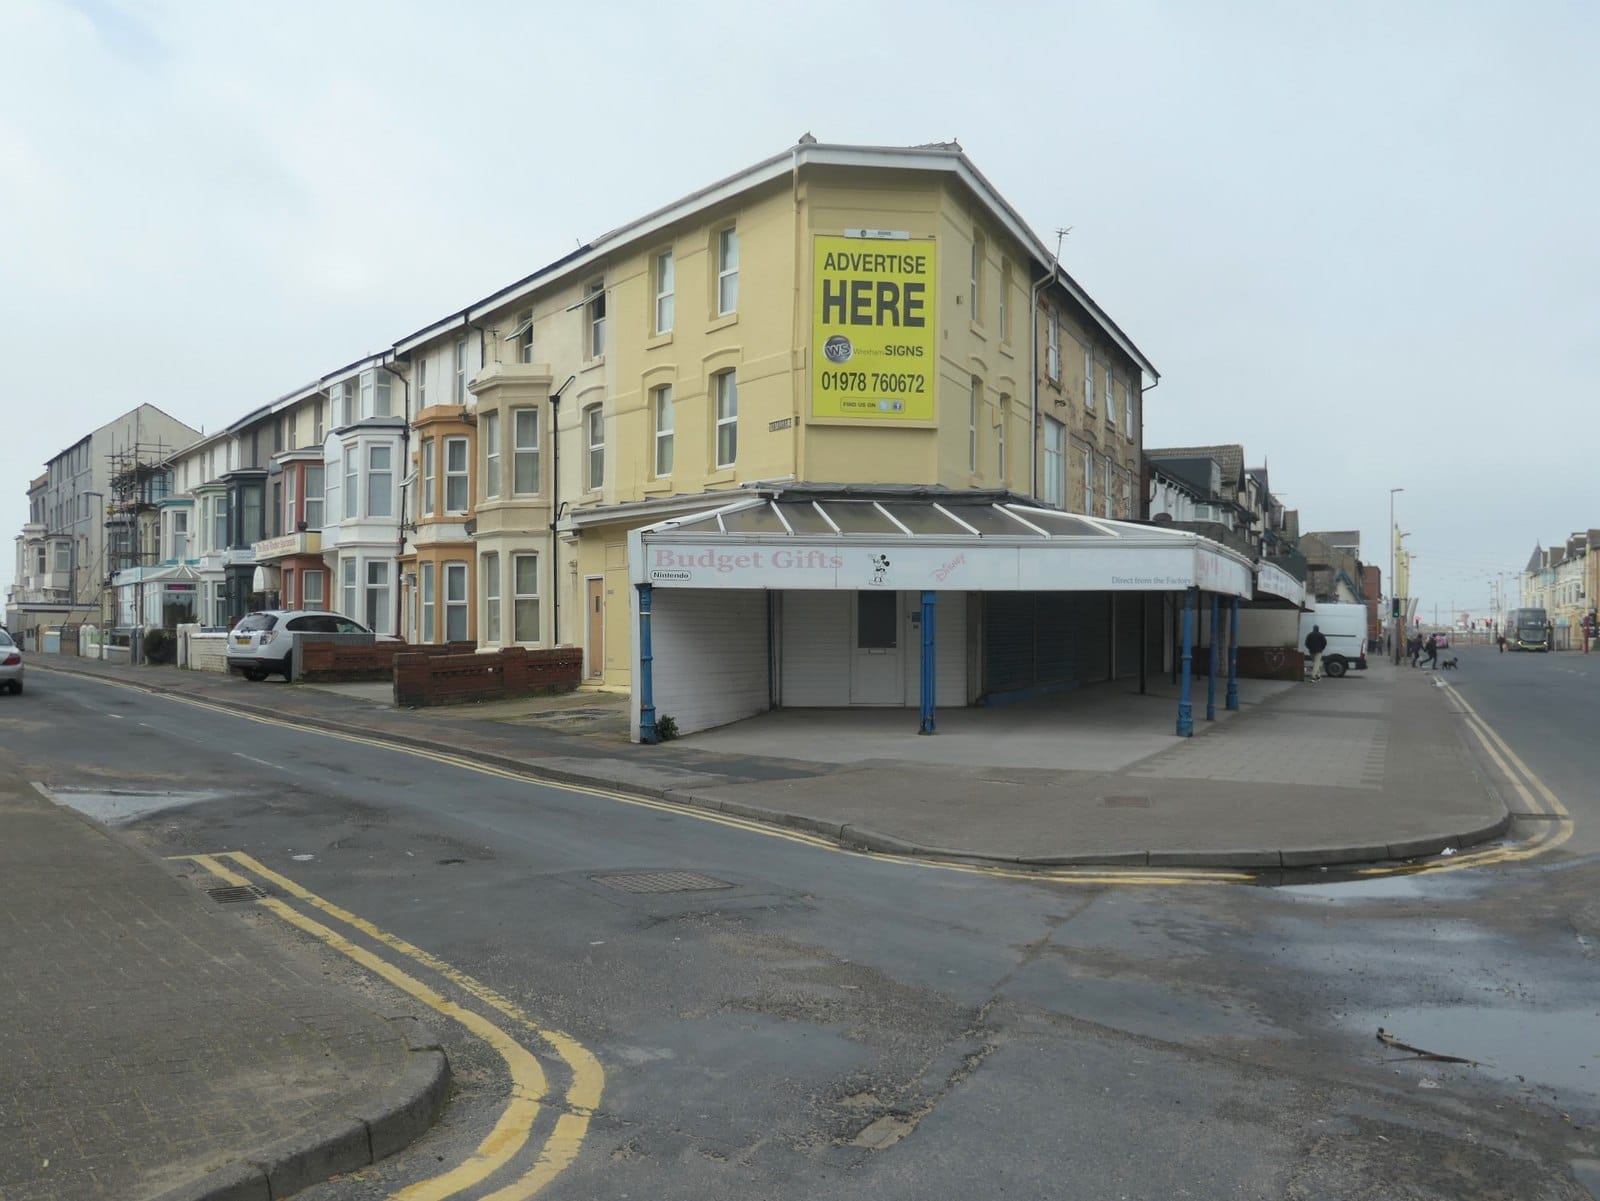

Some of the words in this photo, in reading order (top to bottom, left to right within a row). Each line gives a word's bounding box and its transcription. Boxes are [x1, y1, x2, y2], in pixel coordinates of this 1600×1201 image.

[824, 252, 926, 274] ADVERTISE
[822, 279, 926, 328] HERE
[826, 343, 850, 357] WS
[884, 345, 923, 357] SIGNS
[821, 371, 867, 391] 01978
[871, 373, 925, 393] 760672
[655, 549, 763, 573] Budget
[771, 550, 844, 569] Gifts
[653, 571, 690, 579] Nintendo
[1111, 576, 1134, 585] Direct
[1134, 576, 1152, 585] from
[1153, 576, 1165, 584] the
[1166, 576, 1191, 586] Factory
